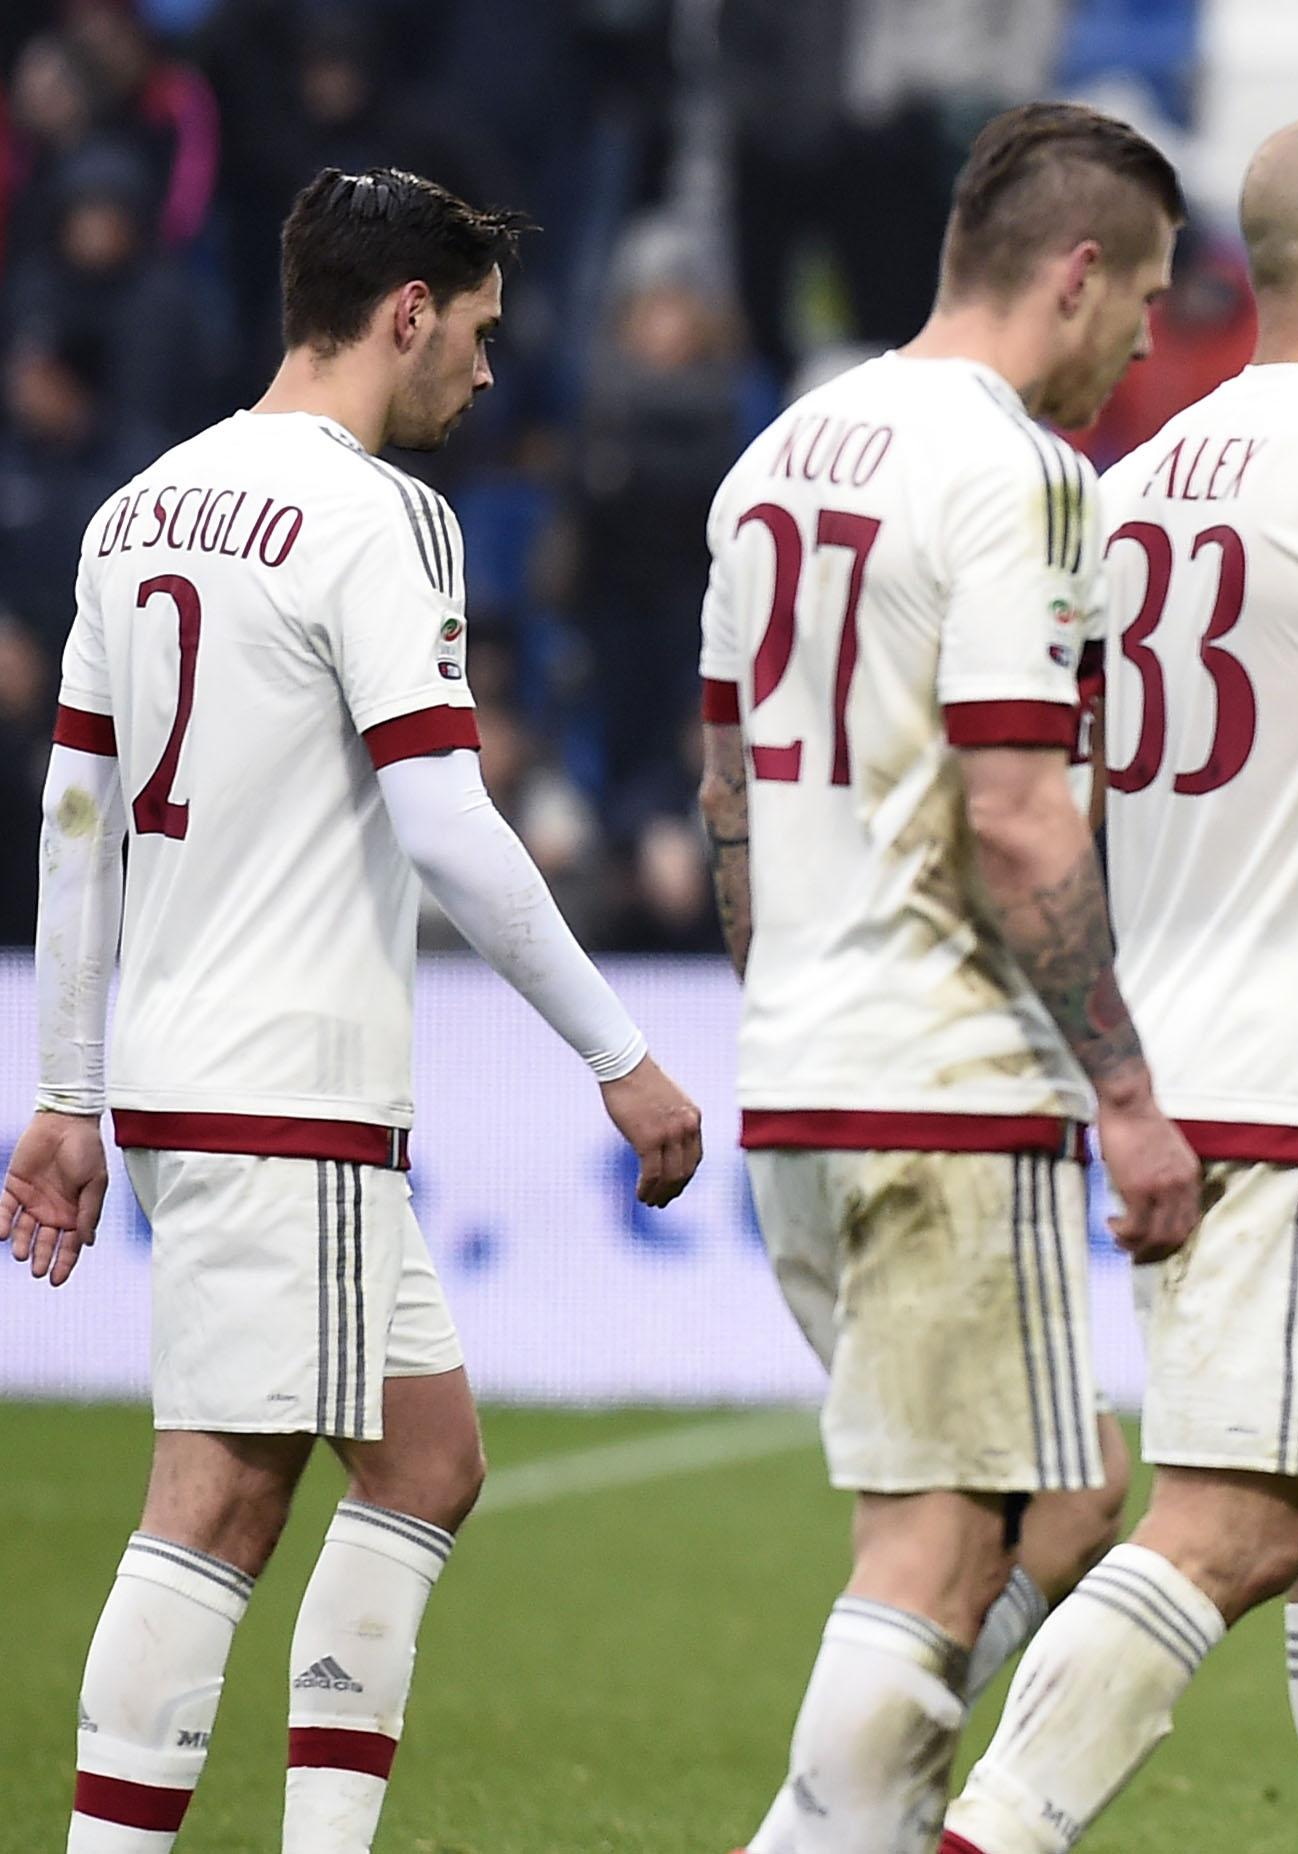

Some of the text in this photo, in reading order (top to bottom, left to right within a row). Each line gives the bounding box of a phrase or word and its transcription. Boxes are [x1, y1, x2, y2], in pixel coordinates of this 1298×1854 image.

[97, 485, 304, 568] DE SCIGLIO
[769, 412, 893, 487] KUCO
[1141, 436, 1269, 500] ALEX
[131, 573, 202, 841] 2
[734, 502, 882, 787] 27
[1103, 521, 1258, 796] 33
